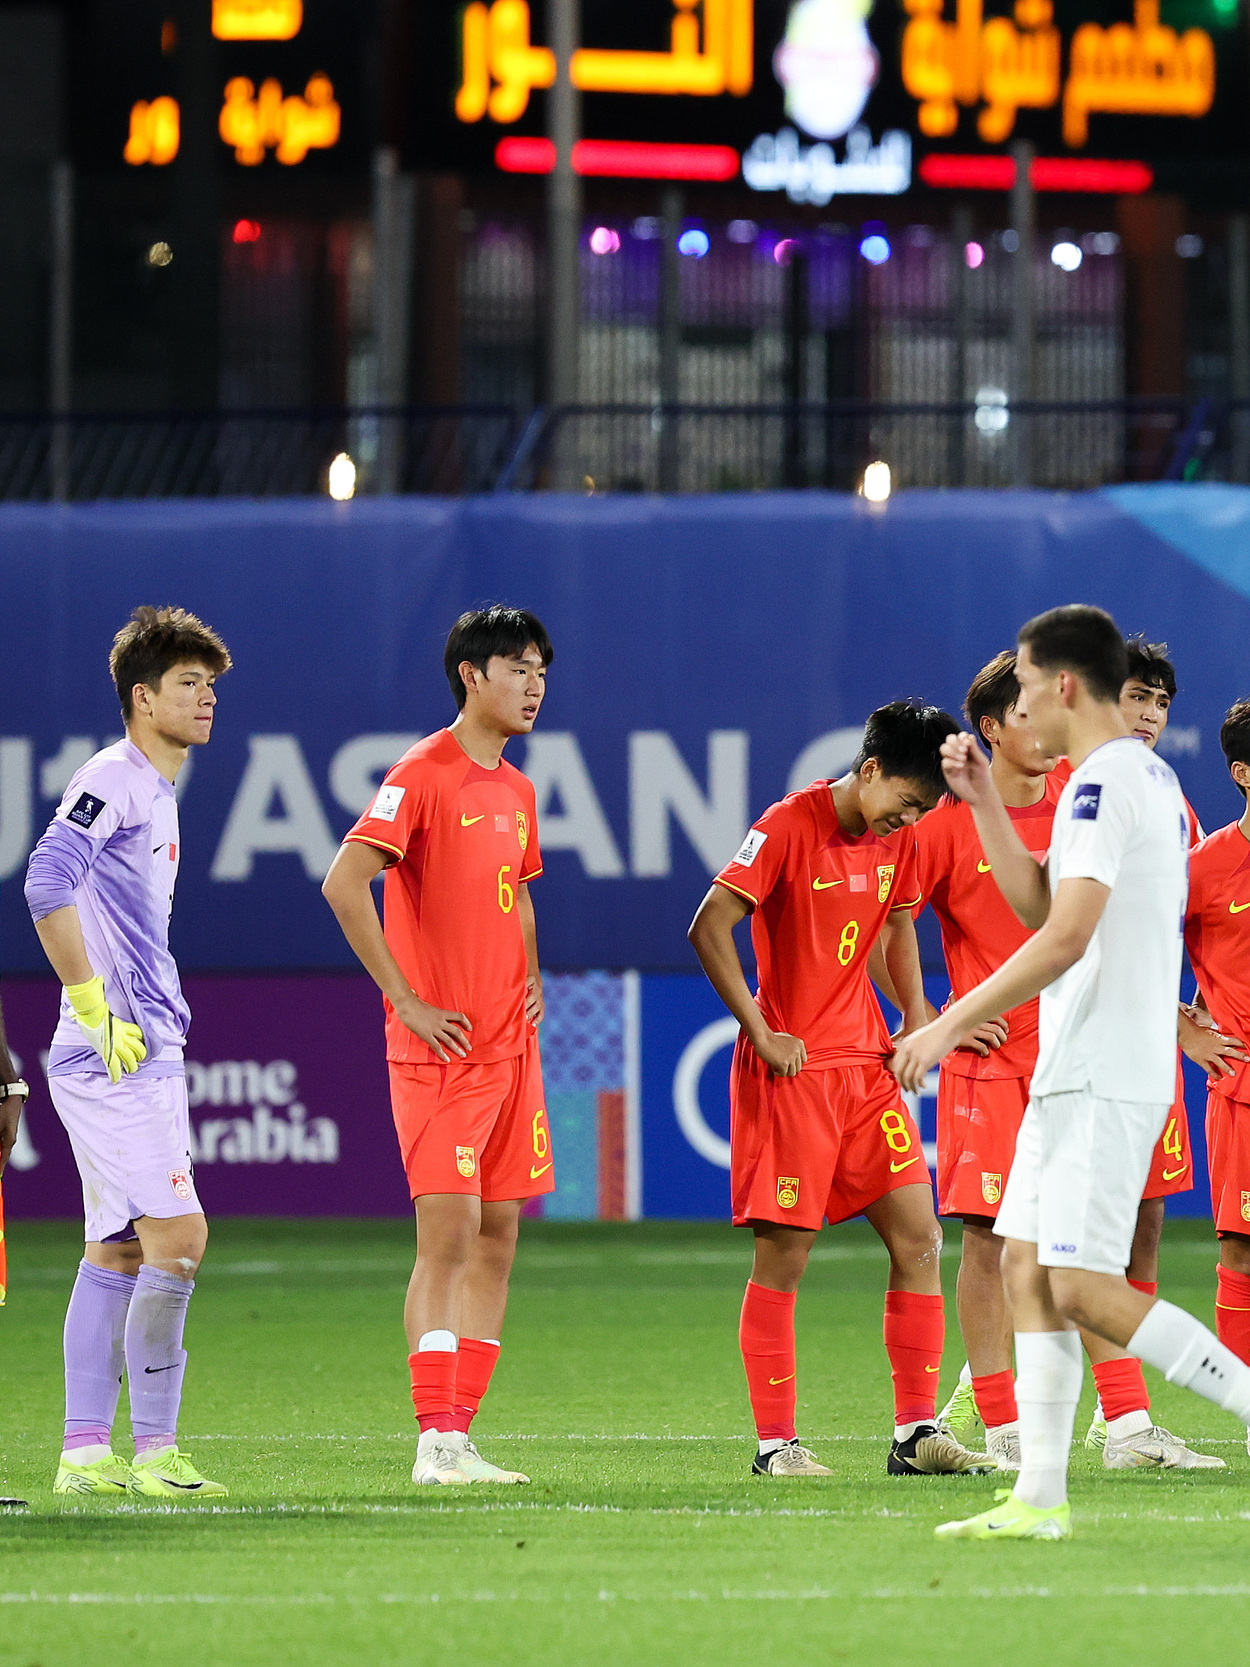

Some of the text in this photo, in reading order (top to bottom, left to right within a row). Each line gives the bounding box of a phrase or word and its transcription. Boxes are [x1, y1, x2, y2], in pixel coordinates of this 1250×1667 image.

[498, 865, 513, 914] 6
[838, 920, 859, 966] 8
[190, 1102, 338, 1164] rabia
[532, 1109, 547, 1159] 6
[880, 1110, 911, 1153] 8
